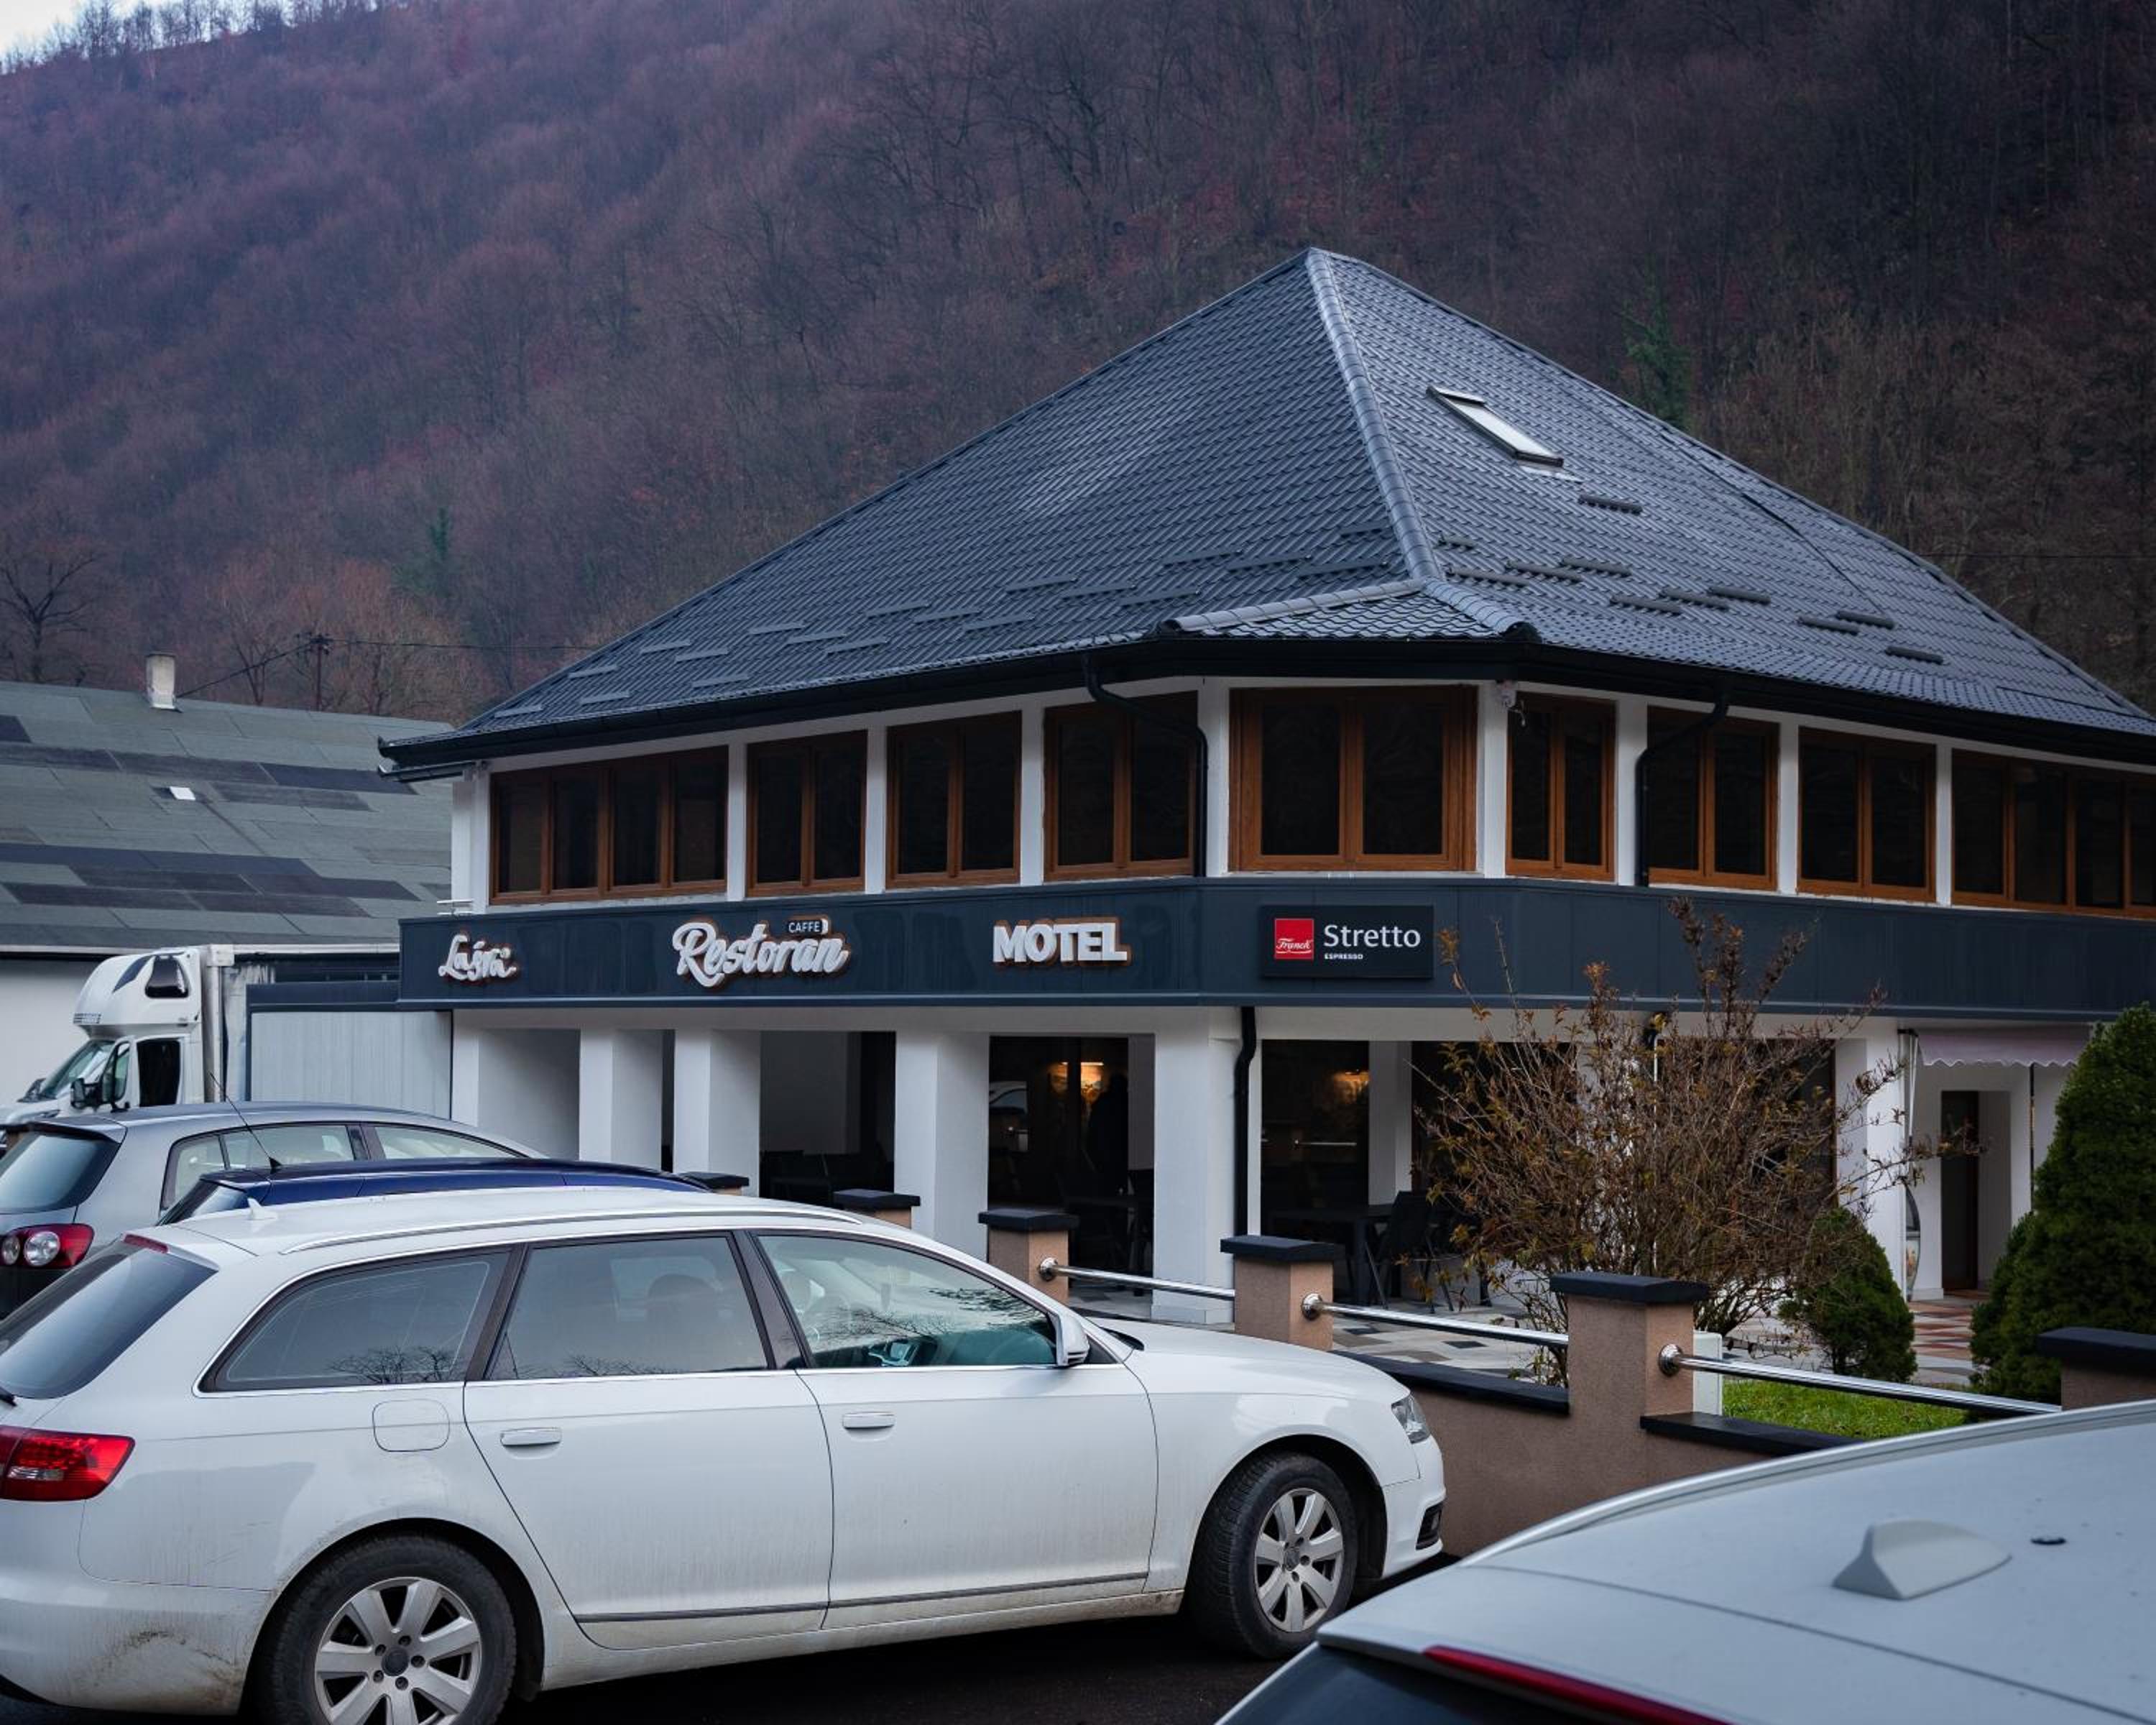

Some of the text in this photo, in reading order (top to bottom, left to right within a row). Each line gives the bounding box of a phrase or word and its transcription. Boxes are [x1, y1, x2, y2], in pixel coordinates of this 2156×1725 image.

[788, 921, 821, 933] CAFFE
[1323, 924, 1422, 947] Stretto
[992, 922, 1128, 962] MOTEL
[1276, 938, 1314, 953] Franck
[672, 922, 849, 988] Restoran
